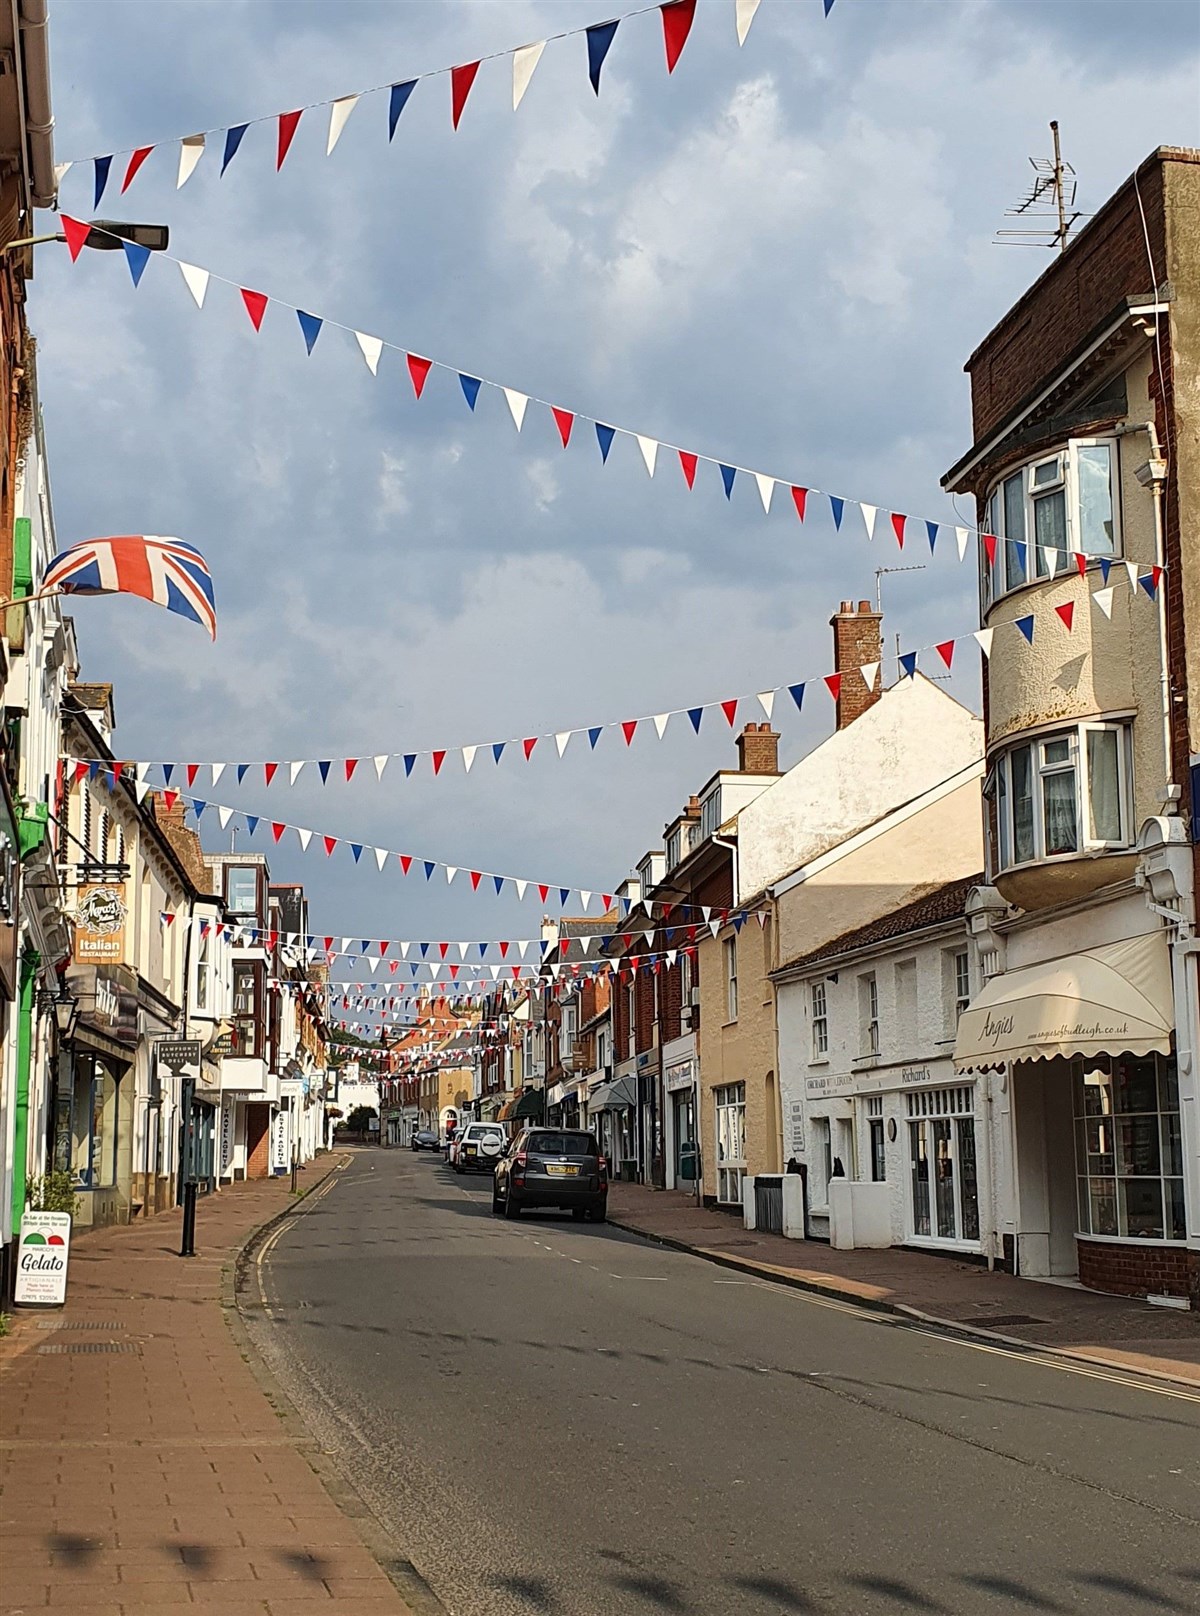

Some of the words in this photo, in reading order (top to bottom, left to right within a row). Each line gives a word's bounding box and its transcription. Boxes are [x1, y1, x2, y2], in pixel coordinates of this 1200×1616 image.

[80, 939, 120, 950] Italian
[978, 1011, 1014, 1047] Angies
[902, 1065, 931, 1084] Richard's
[278, 1140, 286, 1165] AGENTS
[21, 1253, 64, 1272] Gelato
